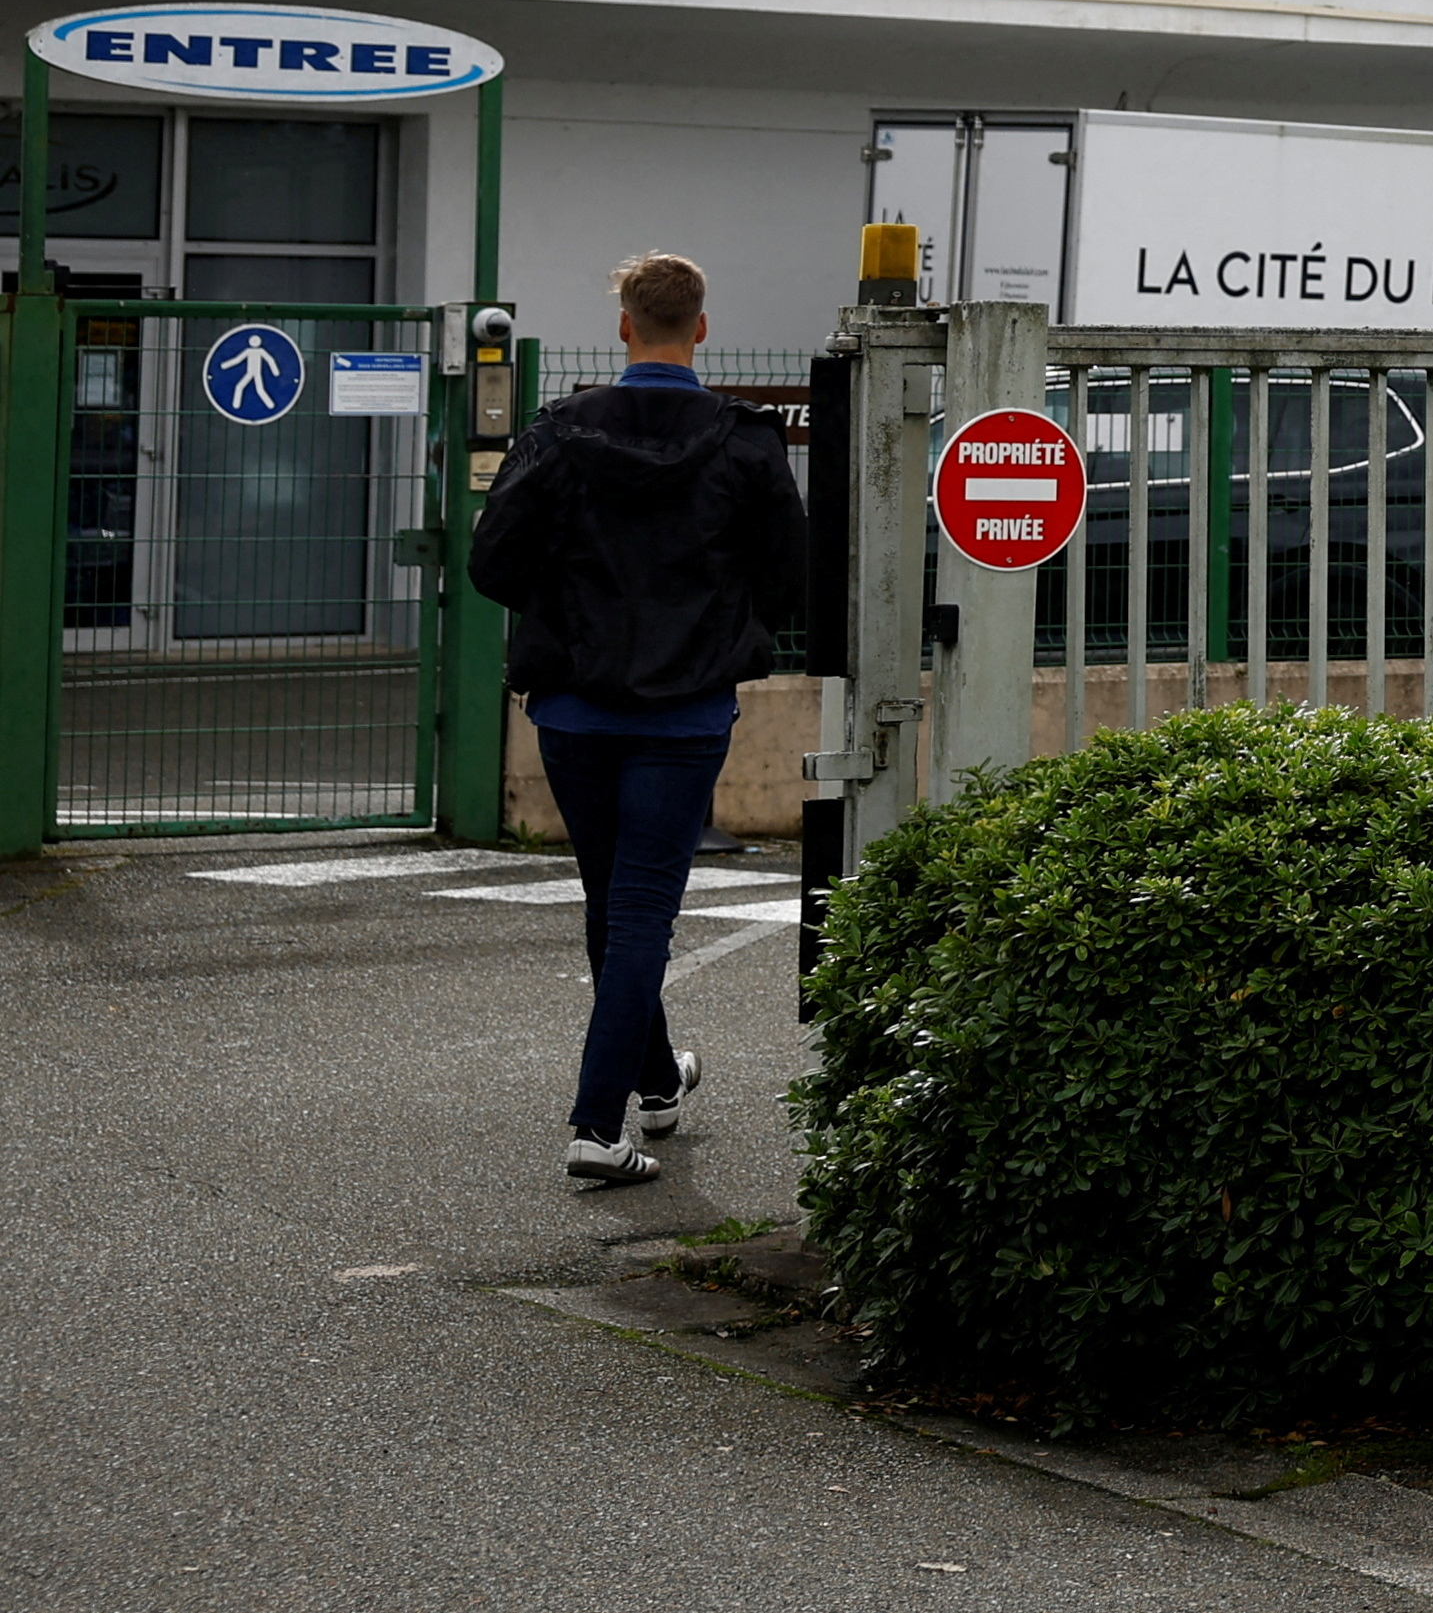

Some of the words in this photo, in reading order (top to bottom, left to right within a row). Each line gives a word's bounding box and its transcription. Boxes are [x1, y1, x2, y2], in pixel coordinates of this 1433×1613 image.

[86, 30, 451, 77] ENTREE
[1137, 247, 1199, 295] LA
[1217, 242, 1327, 300] CITÉ
[1344, 256, 1415, 304] DU
[958, 438, 1066, 465] PROPRIÉTÉ
[975, 514, 1044, 541] PRIVÉE
